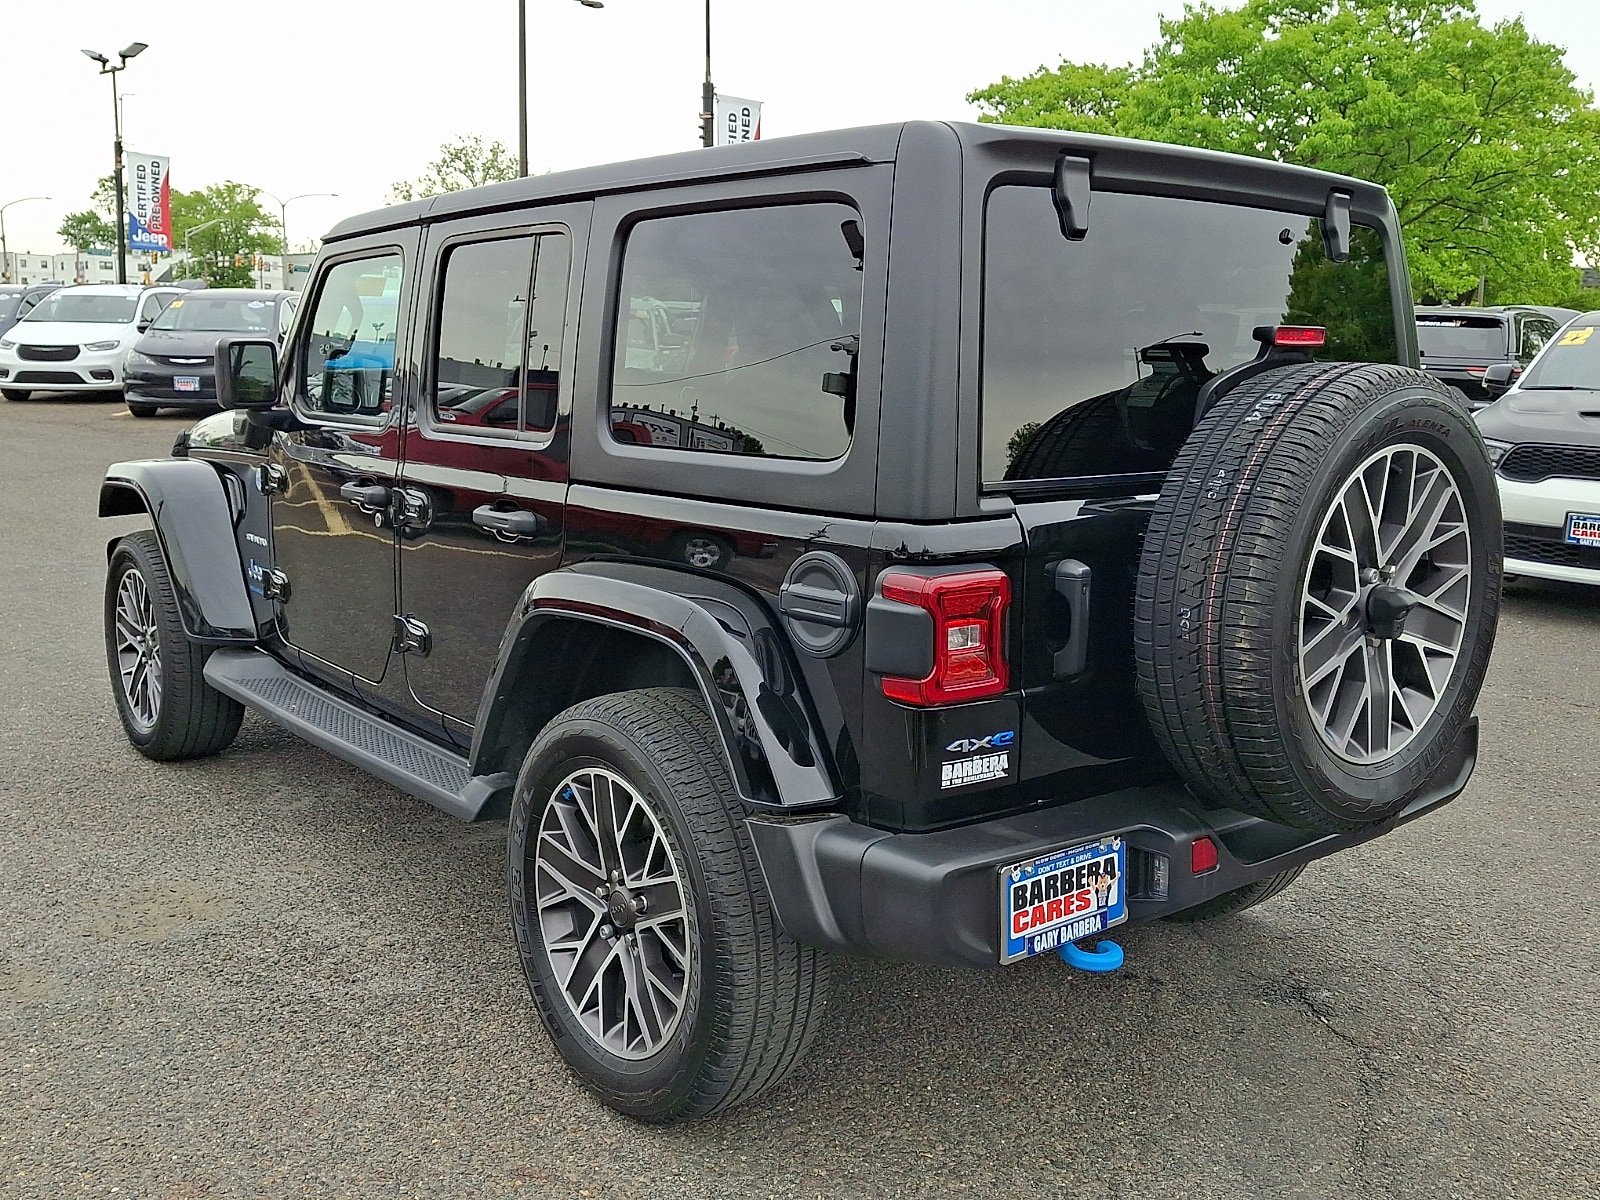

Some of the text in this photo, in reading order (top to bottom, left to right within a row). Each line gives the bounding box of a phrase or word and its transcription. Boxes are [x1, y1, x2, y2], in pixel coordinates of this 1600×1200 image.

[136, 164, 147, 226] CERTIFIED
[132, 229, 168, 246] Jeep
[941, 753, 1009, 781] BARBERA
[1037, 863, 1056, 875] DON'T
[1055, 859, 1070, 869] TEXT
[1075, 852, 1093, 862] DRIVE
[1012, 856, 1117, 912] BARBERA
[1012, 889, 1092, 934] CARES
[1033, 914, 1102, 952] GARY BARBERA
